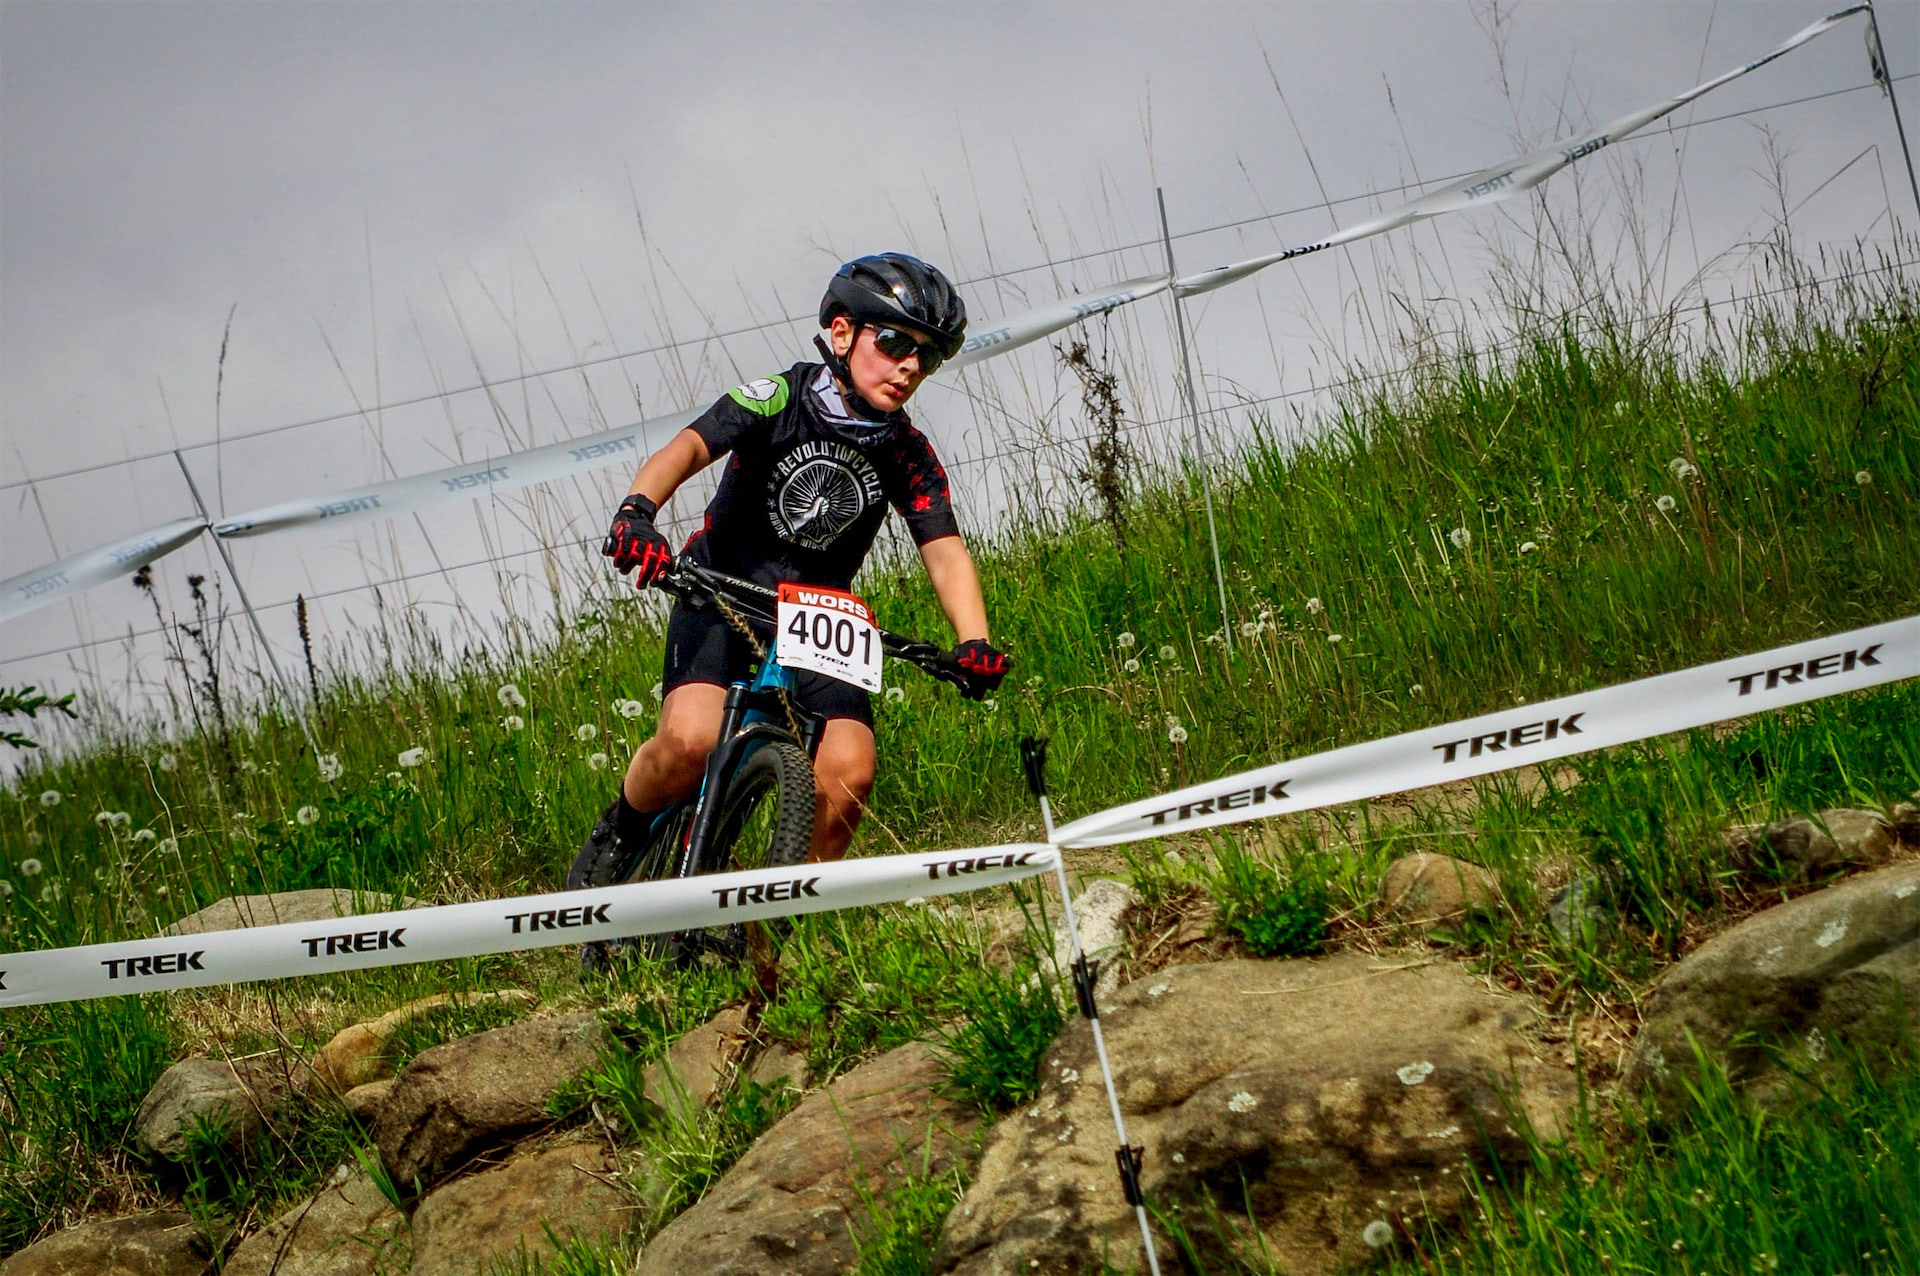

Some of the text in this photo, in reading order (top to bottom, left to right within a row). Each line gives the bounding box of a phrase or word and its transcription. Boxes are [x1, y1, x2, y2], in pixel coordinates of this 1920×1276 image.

[797, 590, 869, 620] WORS
[788, 610, 872, 666] 4001
[812, 652, 850, 668] TREK
[1728, 643, 1885, 697] TREK
[1432, 711, 1586, 763] TREK
[1140, 778, 1292, 826] TREK
[922, 852, 1037, 880] TREK
[712, 876, 822, 909] TREK
[505, 902, 612, 935] TREK
[301, 926, 407, 959] TREK
[101, 947, 206, 980] TREK
